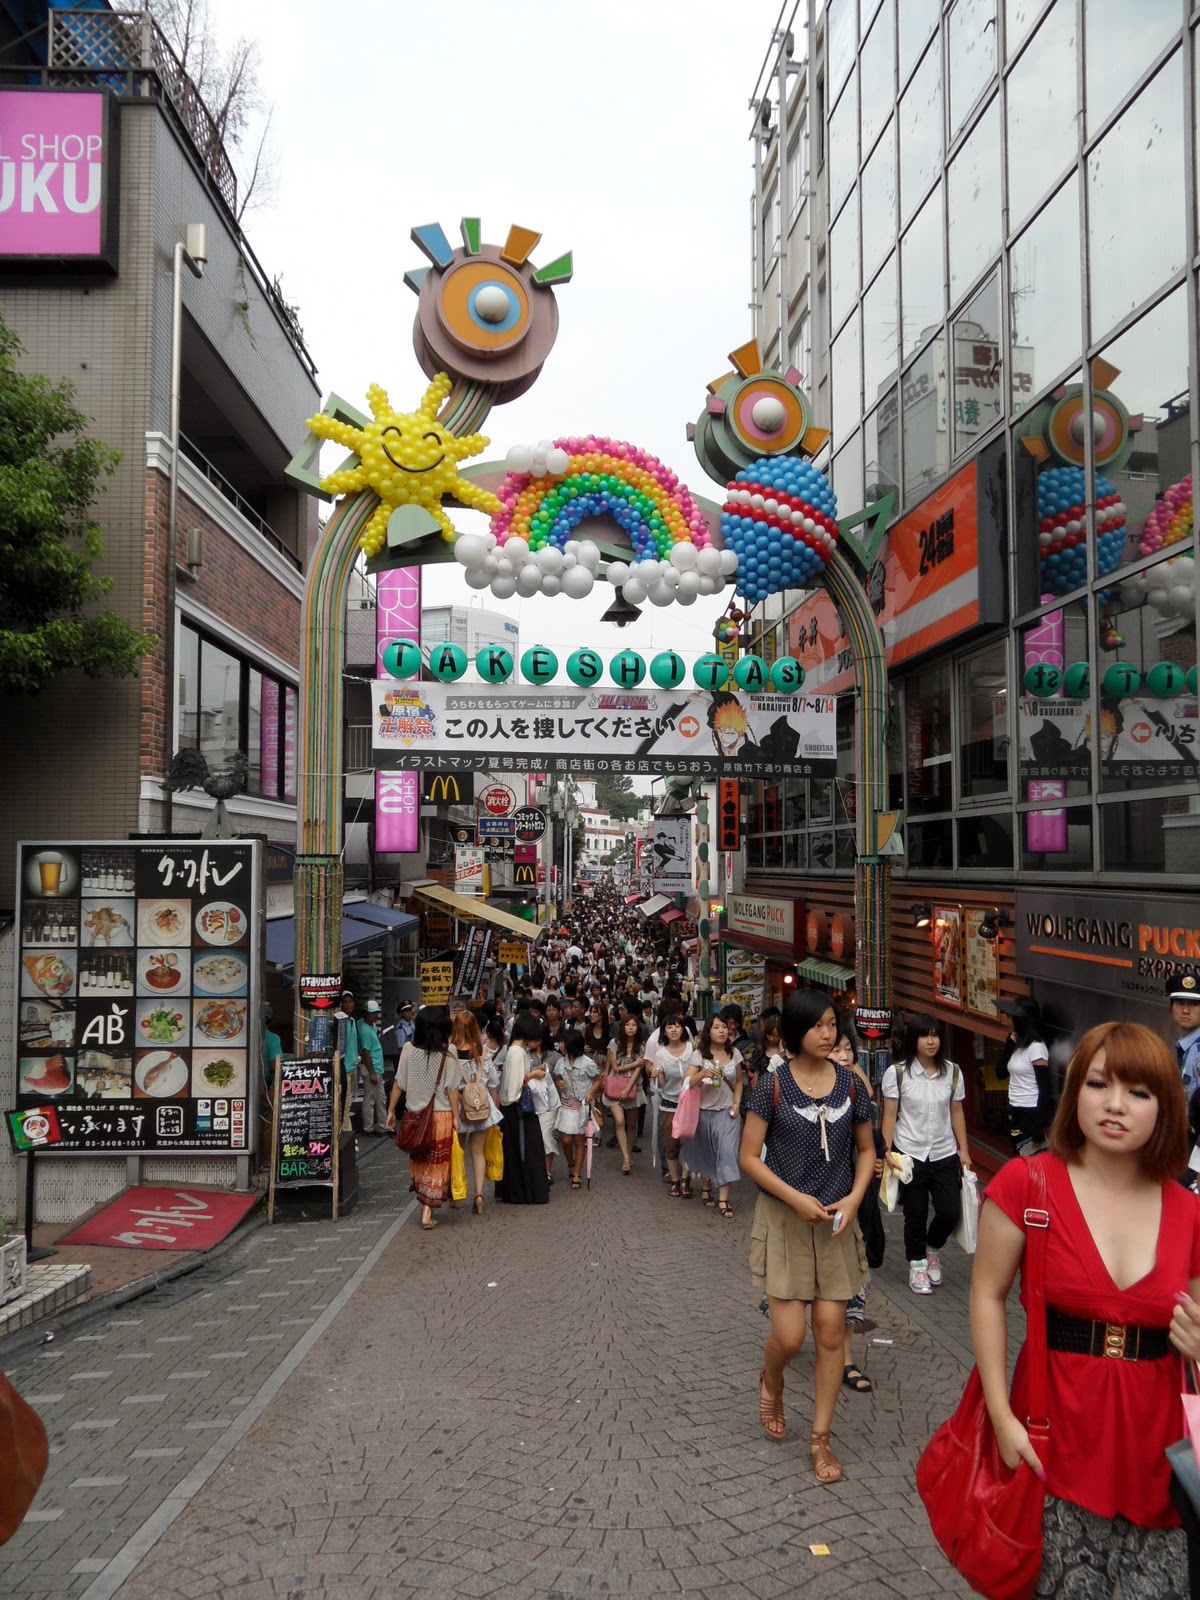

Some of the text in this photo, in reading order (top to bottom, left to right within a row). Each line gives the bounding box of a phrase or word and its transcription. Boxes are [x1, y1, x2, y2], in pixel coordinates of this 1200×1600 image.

[21, 134, 102, 161] SHOP
[918, 522, 936, 577] 24
[450, 700, 575, 709] うちわをもらってゲームに参加!
[444, 716, 676, 740] この人を捜してください
[804, 743, 834, 752] SHUEISHA
[396, 755, 813, 774] イラストマップ夏号完成! 商店街の各お店でもらおう。 原宿竹下通り商店会
[487, 795, 509, 807] 消火栓
[516, 820, 545, 831] ンターネットカフェ
[732, 900, 785, 923] WOLFGANG PUCK
[766, 924, 785, 936] EXPRESS
[1026, 911, 1200, 959] WOLFGANG PUCK
[420, 965, 452, 974] お名前
[81, 1014, 125, 1045] AB
[281, 1077, 324, 1097] PIZZA
[280, 1161, 308, 1177] BAR
